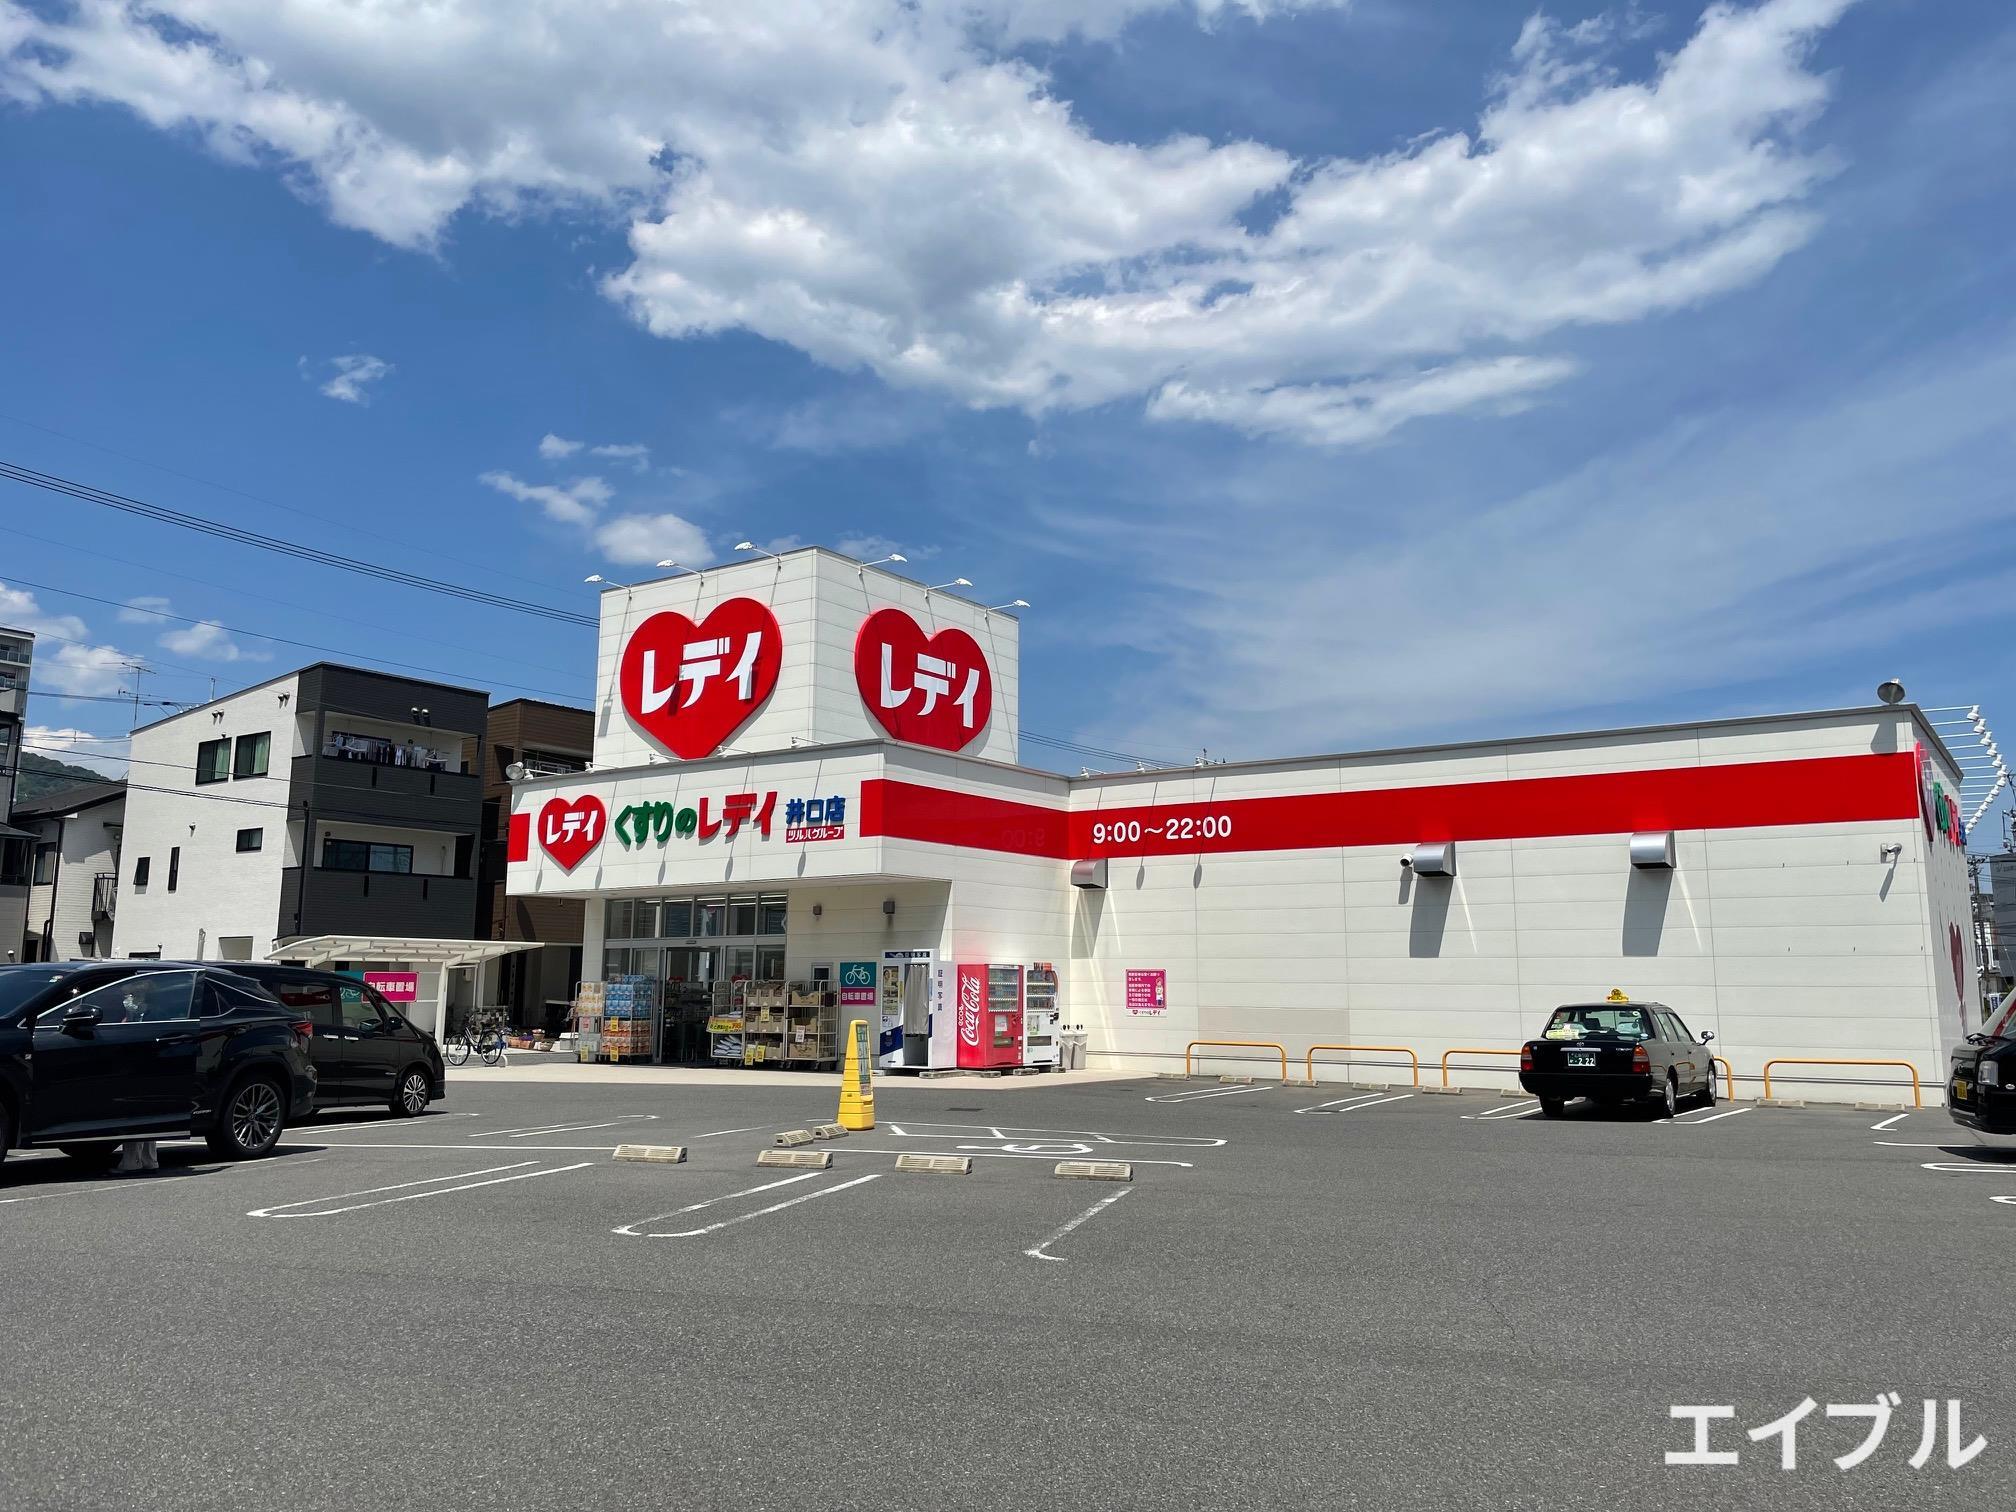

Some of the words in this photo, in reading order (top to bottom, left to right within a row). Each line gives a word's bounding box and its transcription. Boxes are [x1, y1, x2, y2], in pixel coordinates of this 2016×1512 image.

[641, 630, 762, 714] レディ
[880, 642, 980, 729] レディ
[546, 810, 599, 845] レディ
[614, 791, 778, 845] くすりのレディ
[785, 795, 846, 825] 井口店
[787, 826, 844, 841] ツルハグループ
[961, 972, 980, 1046] Coca-Cola
